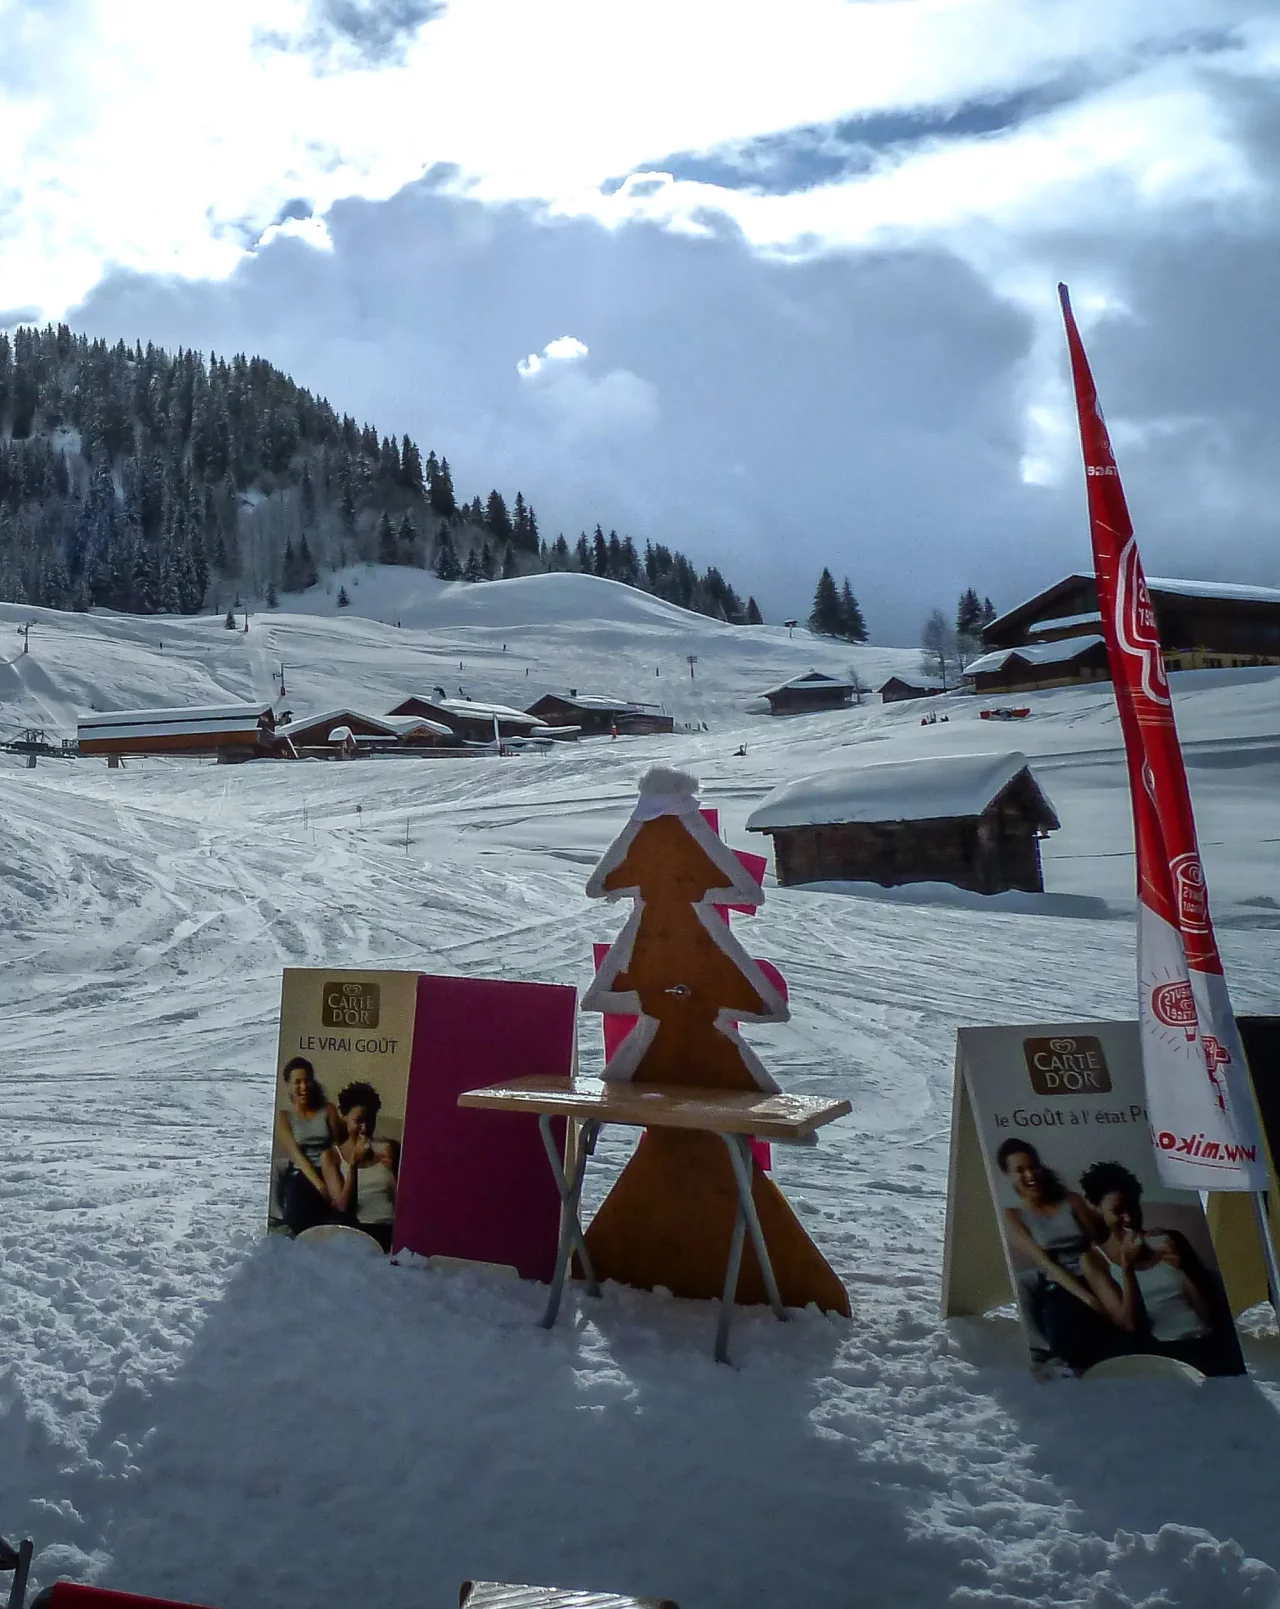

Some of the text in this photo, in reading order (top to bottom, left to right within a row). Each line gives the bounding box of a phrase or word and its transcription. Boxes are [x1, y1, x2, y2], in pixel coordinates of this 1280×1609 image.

[328, 993, 374, 1011] CARTE
[333, 1009, 370, 1025] D'OR
[299, 1036, 316, 1050] LE
[319, 1037, 351, 1052] VRAI
[1033, 1051, 1101, 1071] CARTE
[1046, 1069, 1100, 1090] D'OR
[994, 1113, 1010, 1128] le
[1013, 1107, 1065, 1127] Goût
